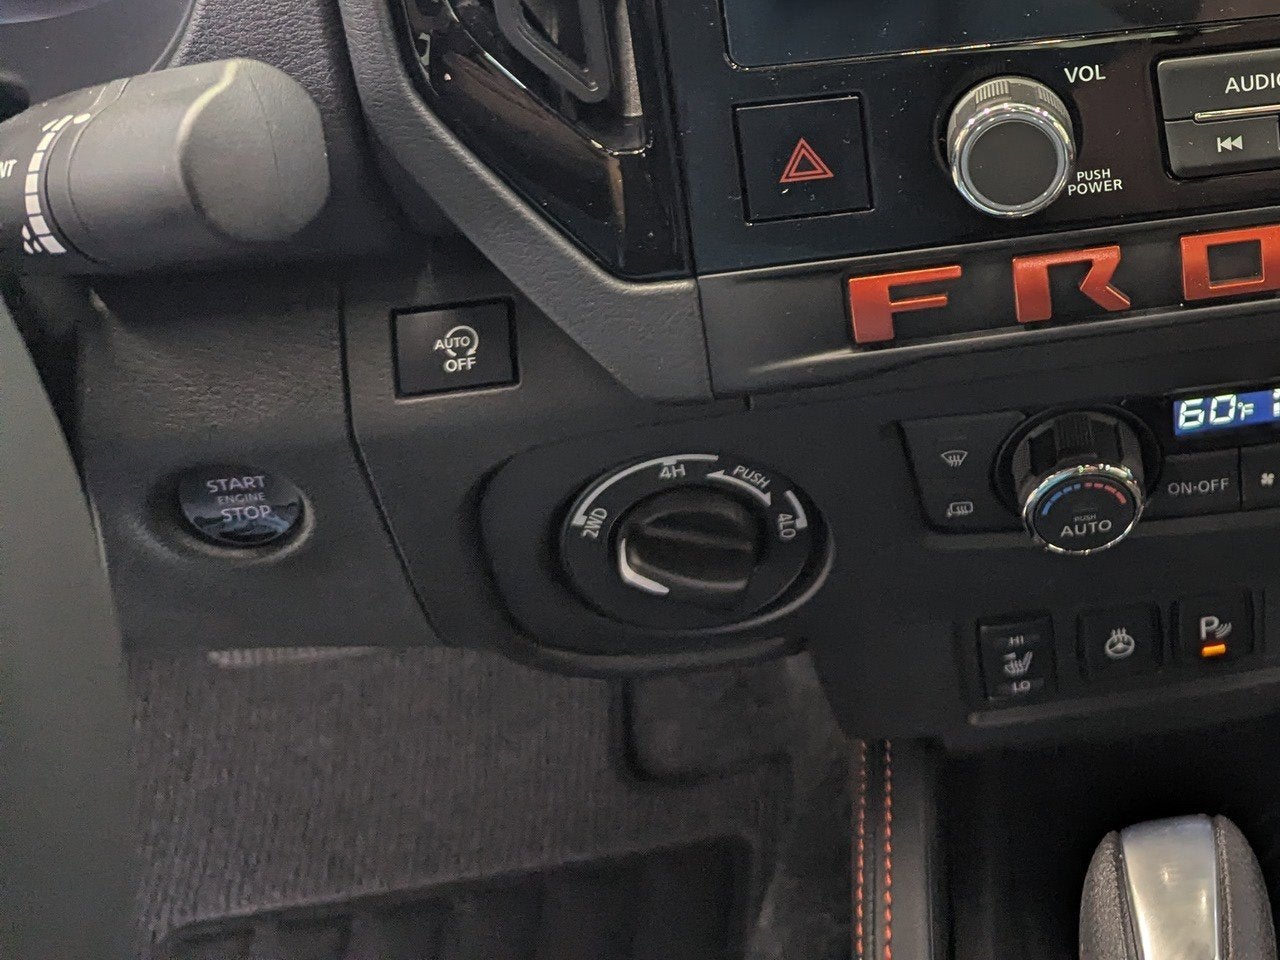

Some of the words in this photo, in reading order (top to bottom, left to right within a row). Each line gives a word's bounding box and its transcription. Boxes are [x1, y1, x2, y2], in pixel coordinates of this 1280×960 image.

[1064, 64, 1106, 83] VOL
[1077, 168, 1111, 182] PUSH
[1067, 178, 1123, 196] POWER
[433, 335, 471, 351] AUTO
[443, 357, 477, 373] OFF
[659, 463, 687, 480] 4H
[732, 464, 772, 489] PUSH
[206, 475, 266, 494] START
[217, 492, 266, 505] ENGINE
[221, 505, 272, 521] STOP
[580, 507, 609, 540] 2WD
[777, 512, 797, 540] 4LO
[1060, 520, 1112, 538] AUTO
